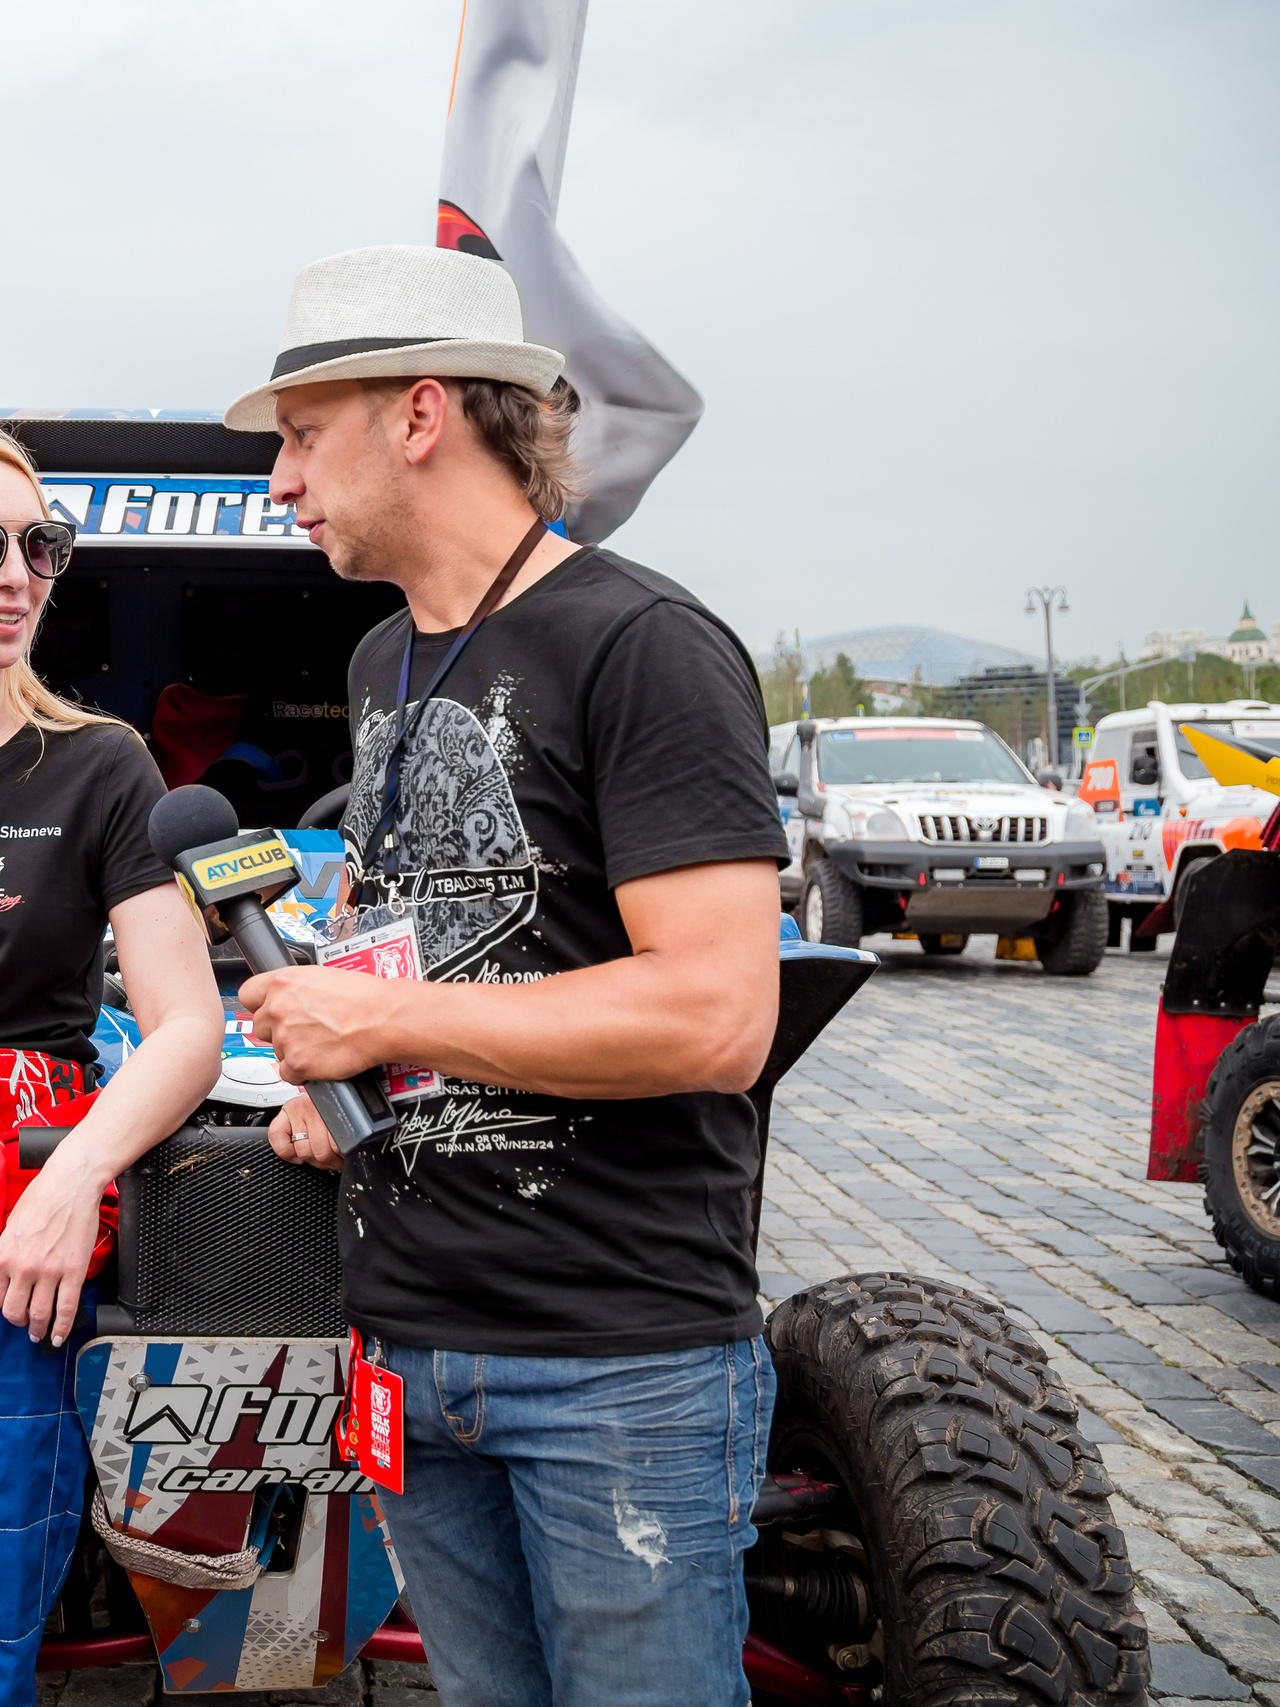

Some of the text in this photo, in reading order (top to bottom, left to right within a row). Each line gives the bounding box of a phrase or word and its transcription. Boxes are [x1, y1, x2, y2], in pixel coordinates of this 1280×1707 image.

[98, 484, 311, 536] Fore
[0, 826, 62, 839] Shtaneva
[207, 847, 287, 881] ATVCLUB
[475, 1133, 506, 1144] OR ON
[371, 1411, 391, 1427] SILK
[371, 1420, 391, 1438] WAY
